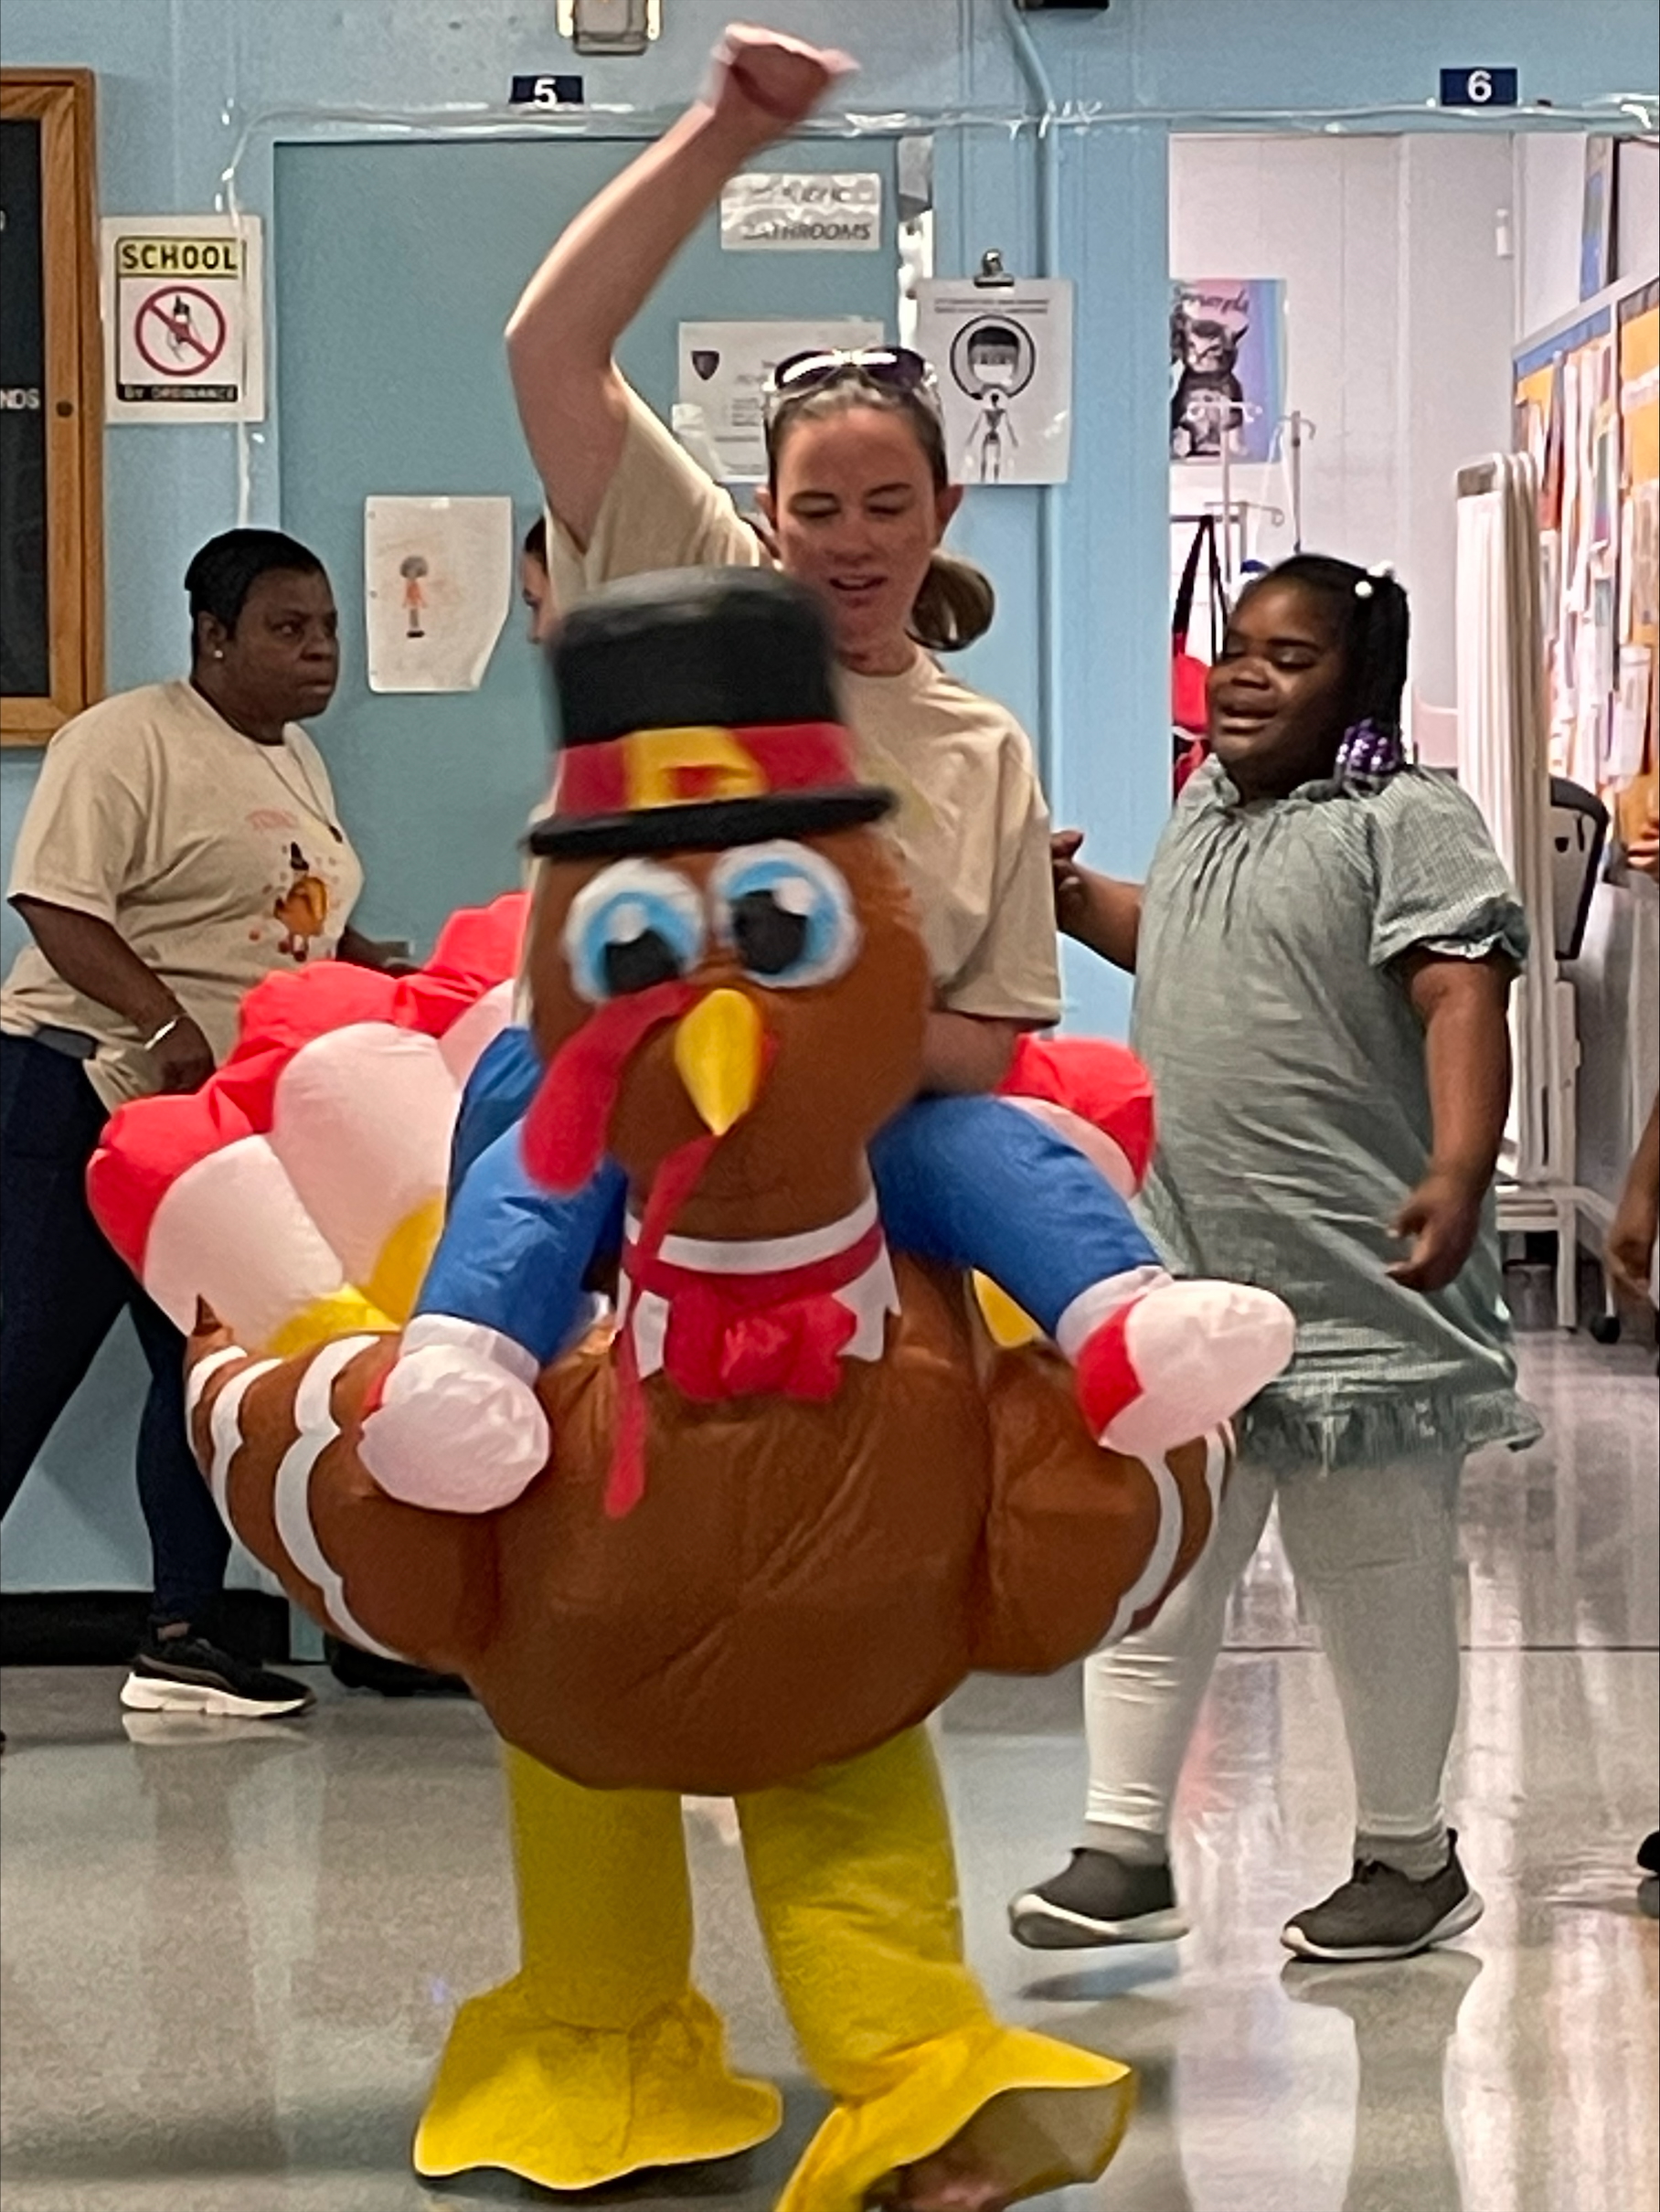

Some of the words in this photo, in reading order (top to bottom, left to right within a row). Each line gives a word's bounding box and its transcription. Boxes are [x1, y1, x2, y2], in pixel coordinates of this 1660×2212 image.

[534, 78, 558, 109] 5
[1468, 69, 1492, 102] 6
[743, 223, 871, 240] THROOMS
[122, 244, 237, 269] SCHOOL
